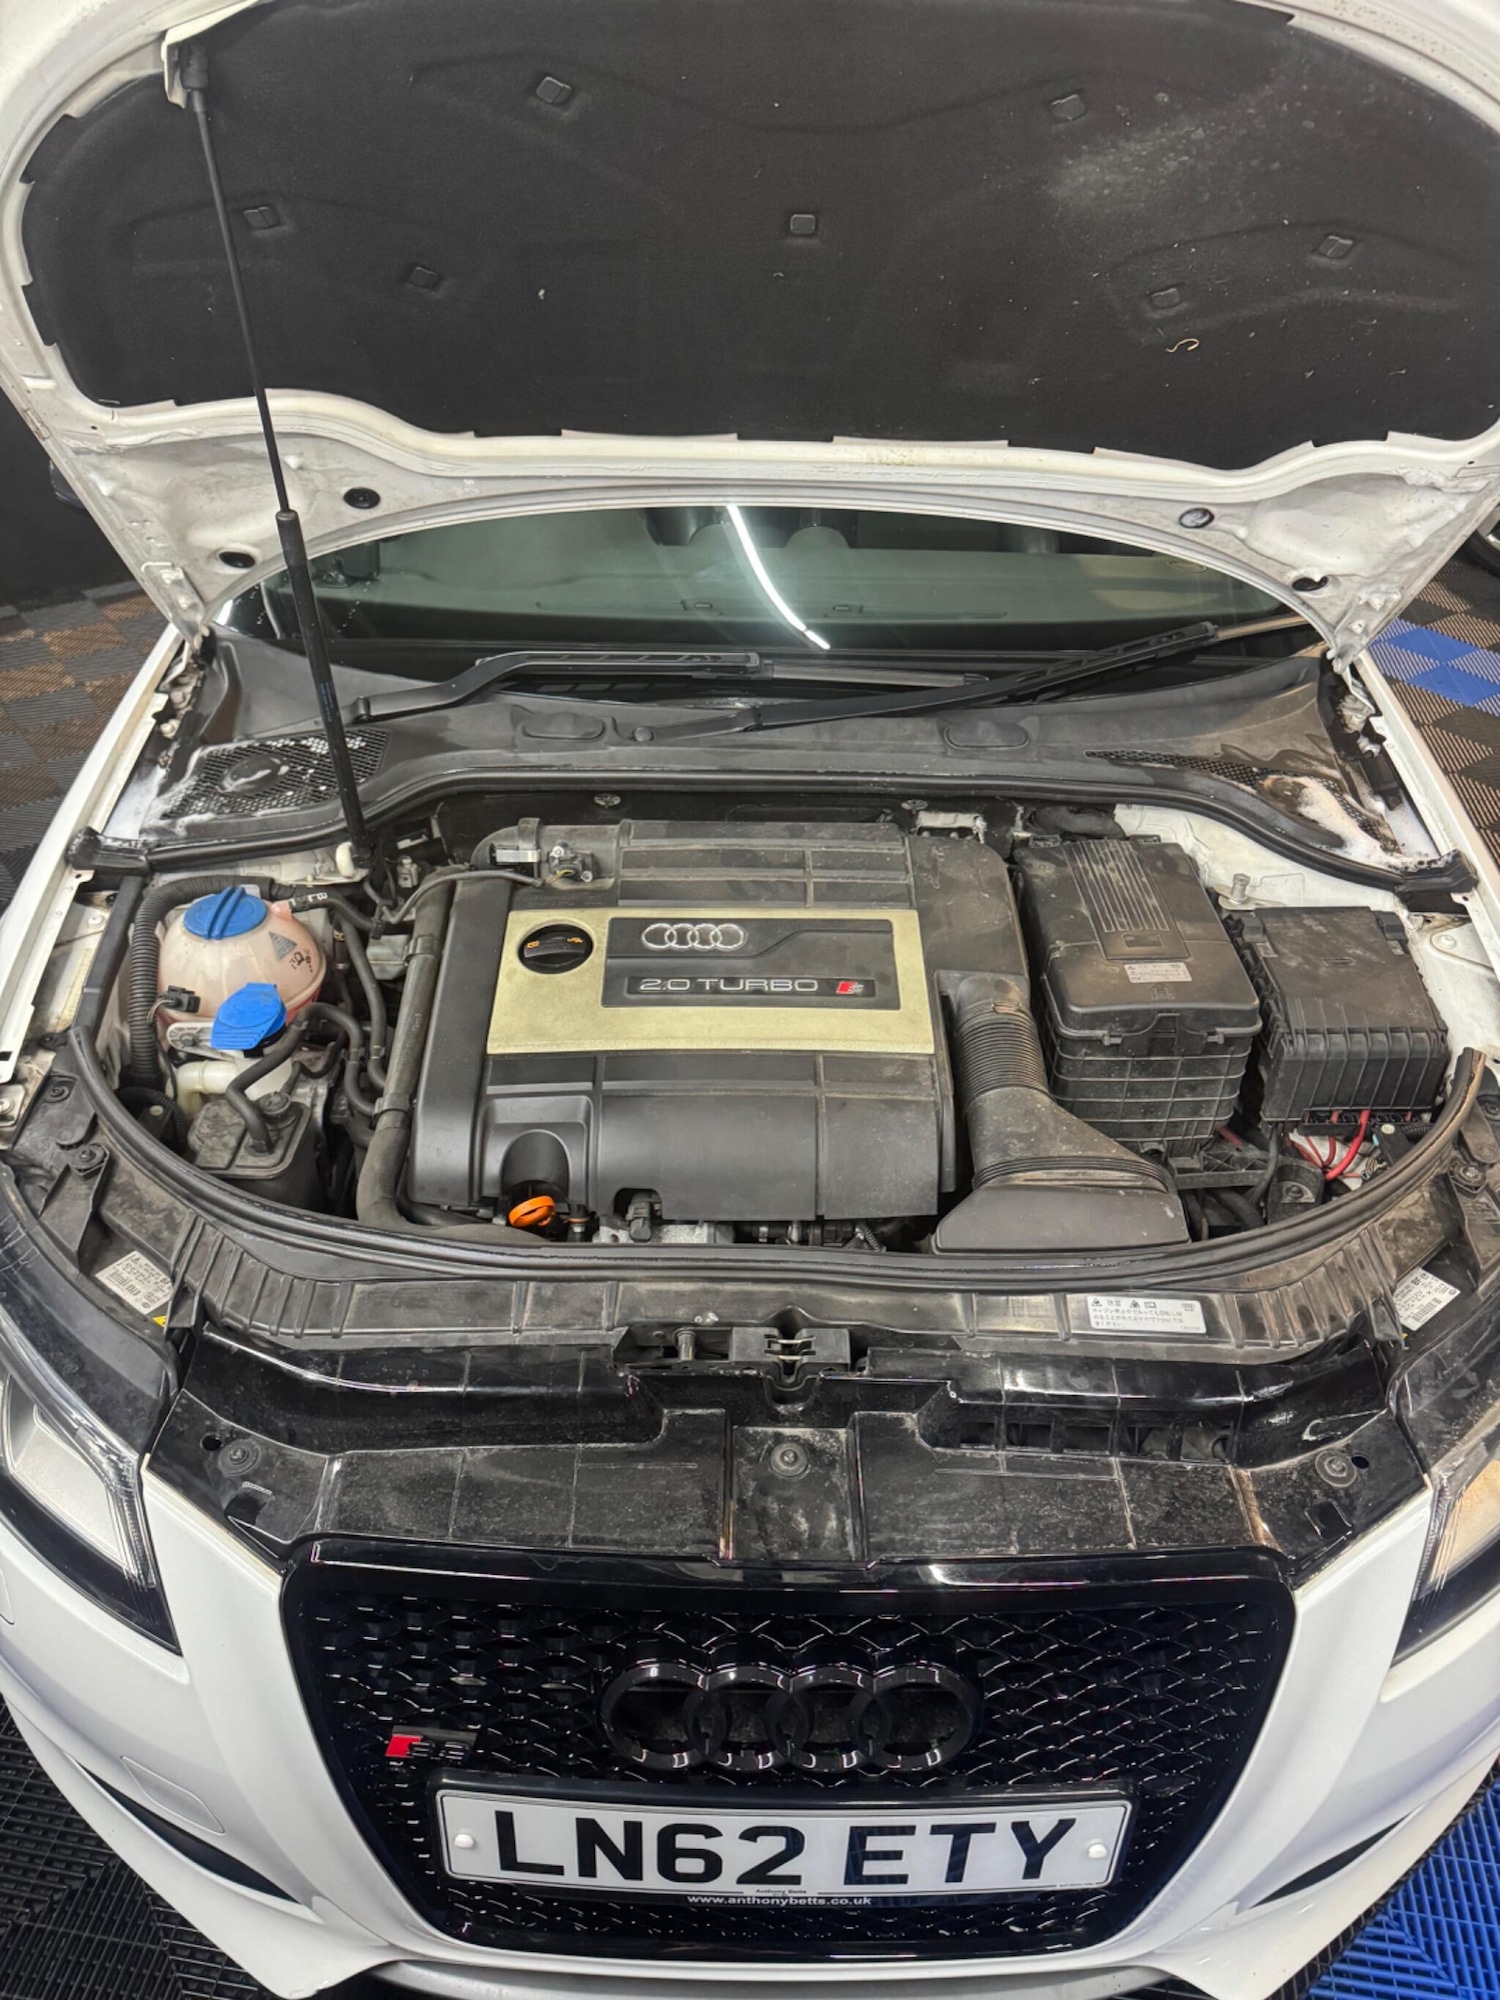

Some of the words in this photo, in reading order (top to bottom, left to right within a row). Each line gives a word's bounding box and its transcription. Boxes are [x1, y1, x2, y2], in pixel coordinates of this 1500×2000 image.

[640, 978, 689, 992] 2.0
[698, 978, 818, 992] TURBO
[493, 1810, 806, 1886] LN62
[843, 1817, 1078, 1886] ETY
[687, 1895, 871, 1906] www.anthonybetts.co.uk
